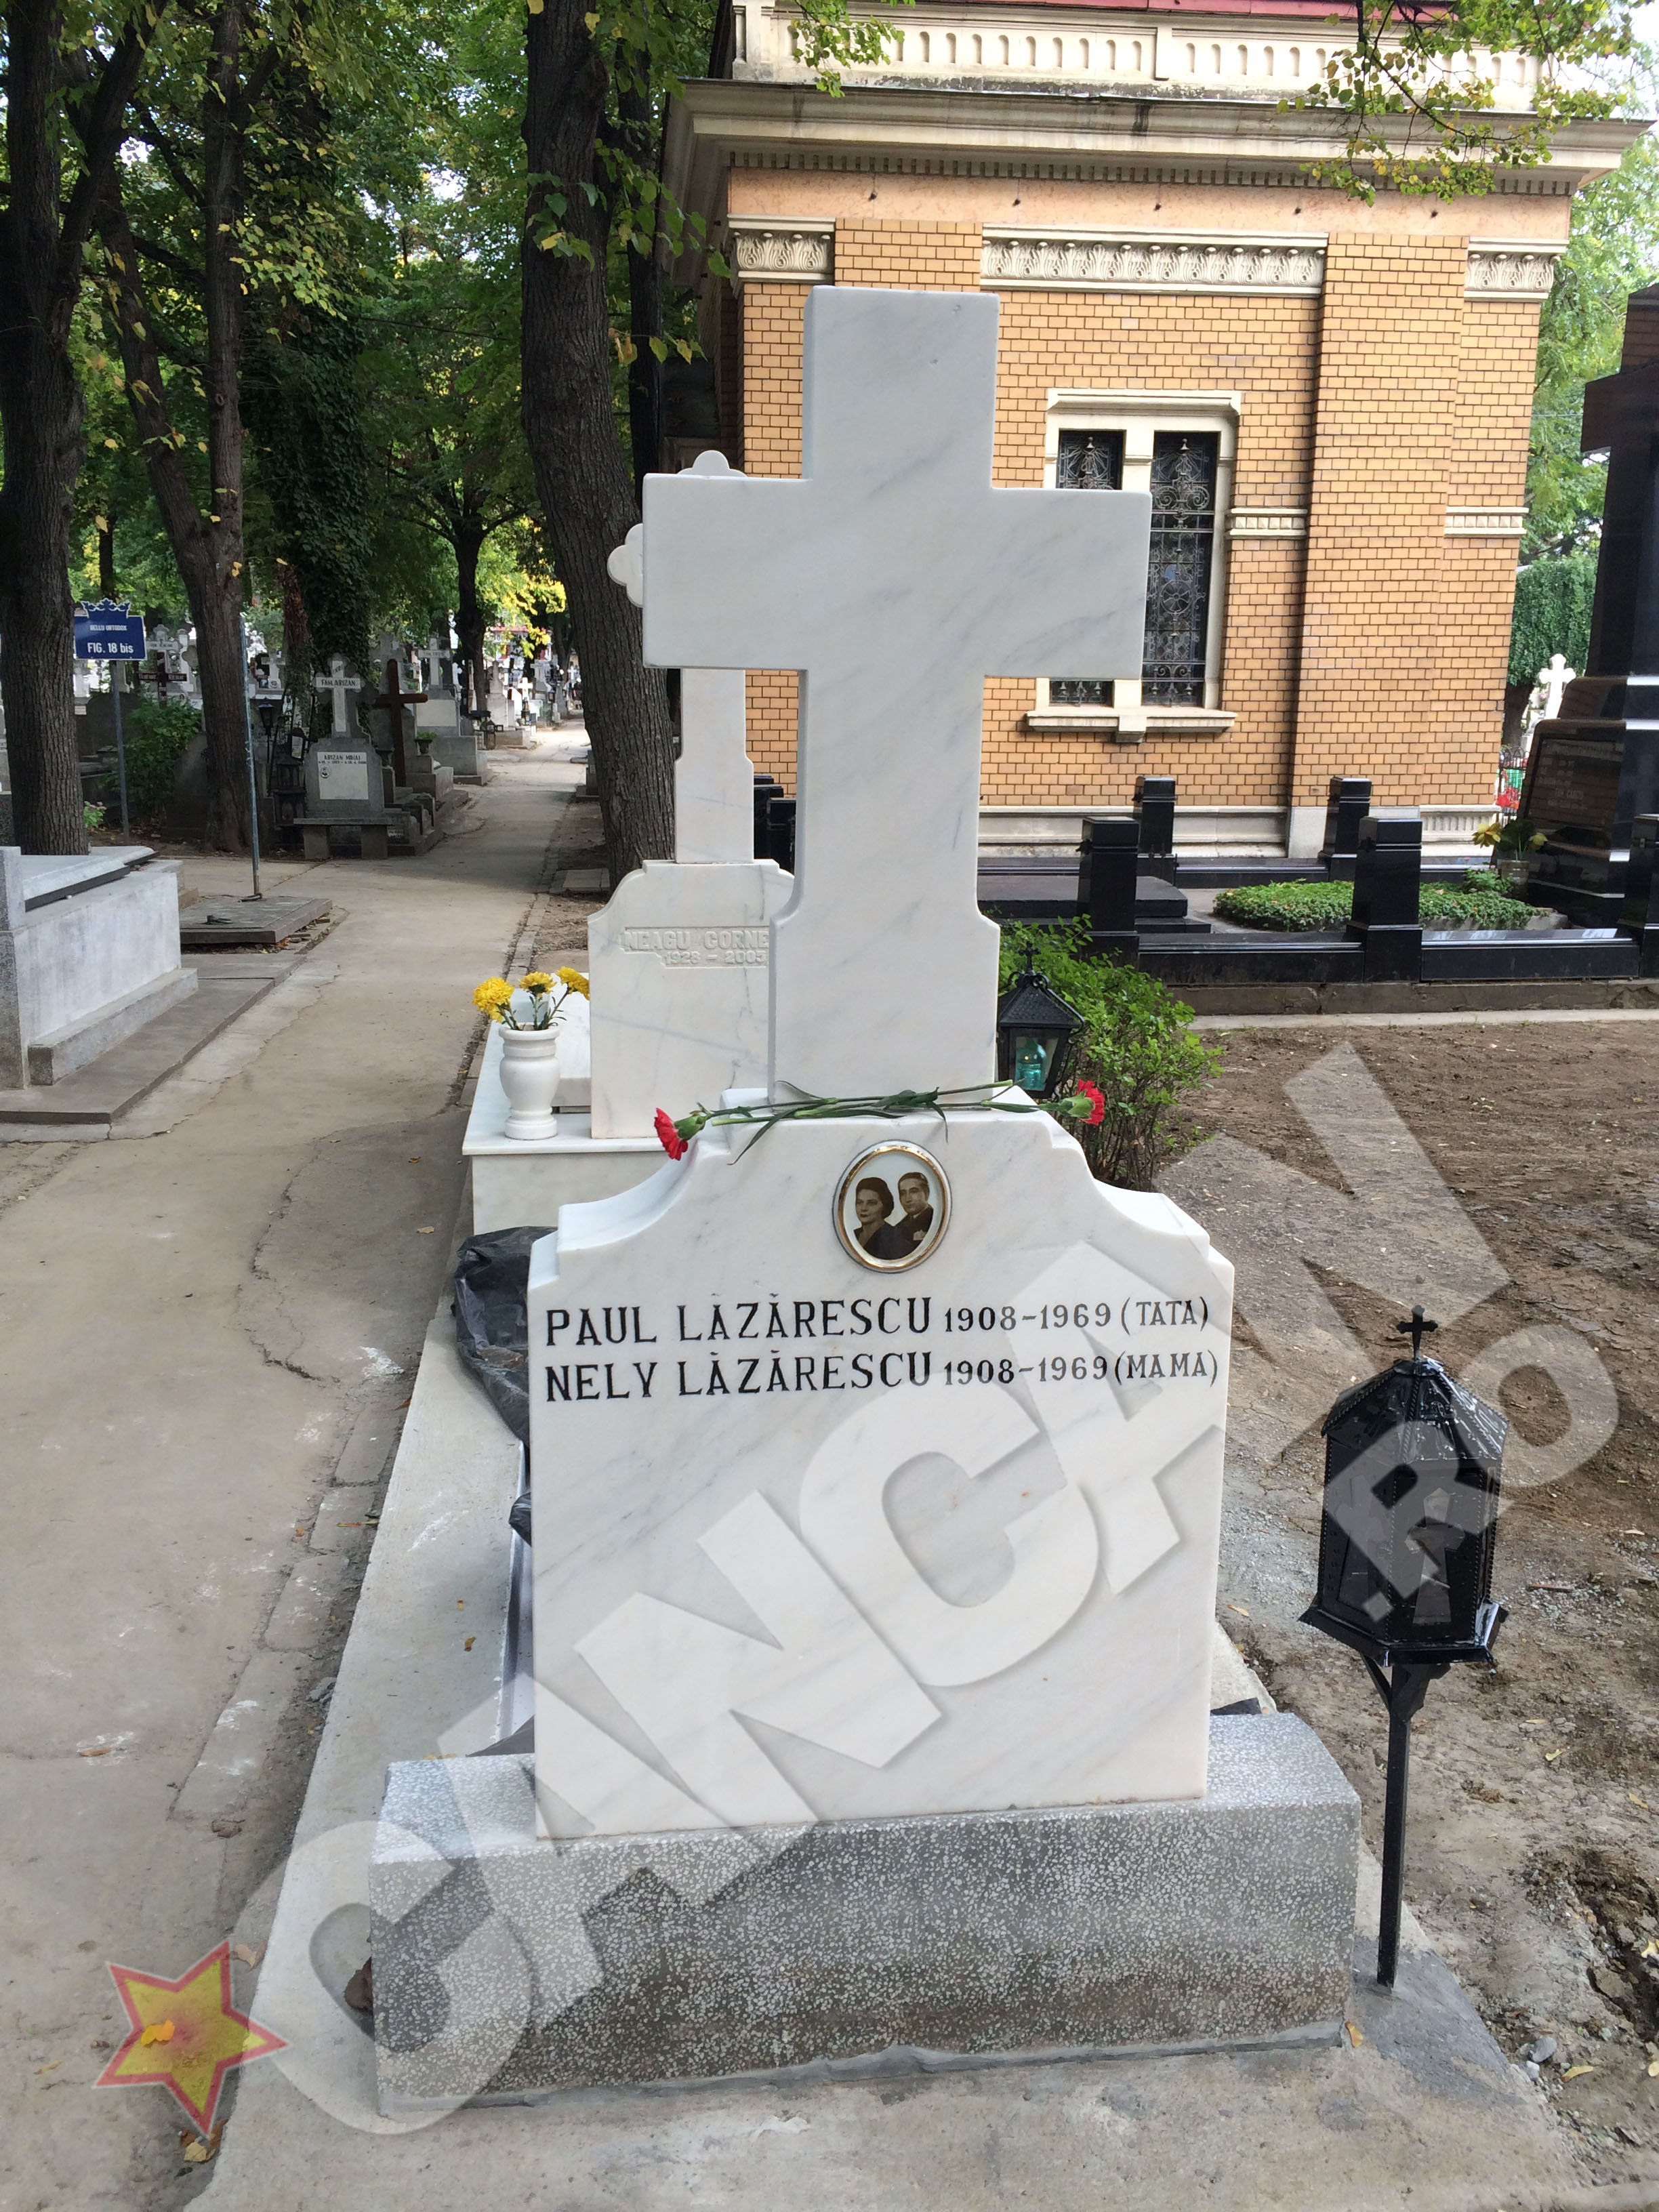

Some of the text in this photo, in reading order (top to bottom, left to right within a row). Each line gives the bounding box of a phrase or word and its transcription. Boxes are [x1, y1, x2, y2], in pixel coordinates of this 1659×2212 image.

[87, 642, 134, 653] FIG. 18 bis
[623, 930, 691, 949] NEAGU
[723, 950, 767, 964] 2005
[546, 1306, 657, 1346] PAUL
[1121, 1296, 1208, 1336] (TATA)
[545, 1361, 658, 1401] NELY
[1114, 1349, 1218, 1387] (MAMA)
